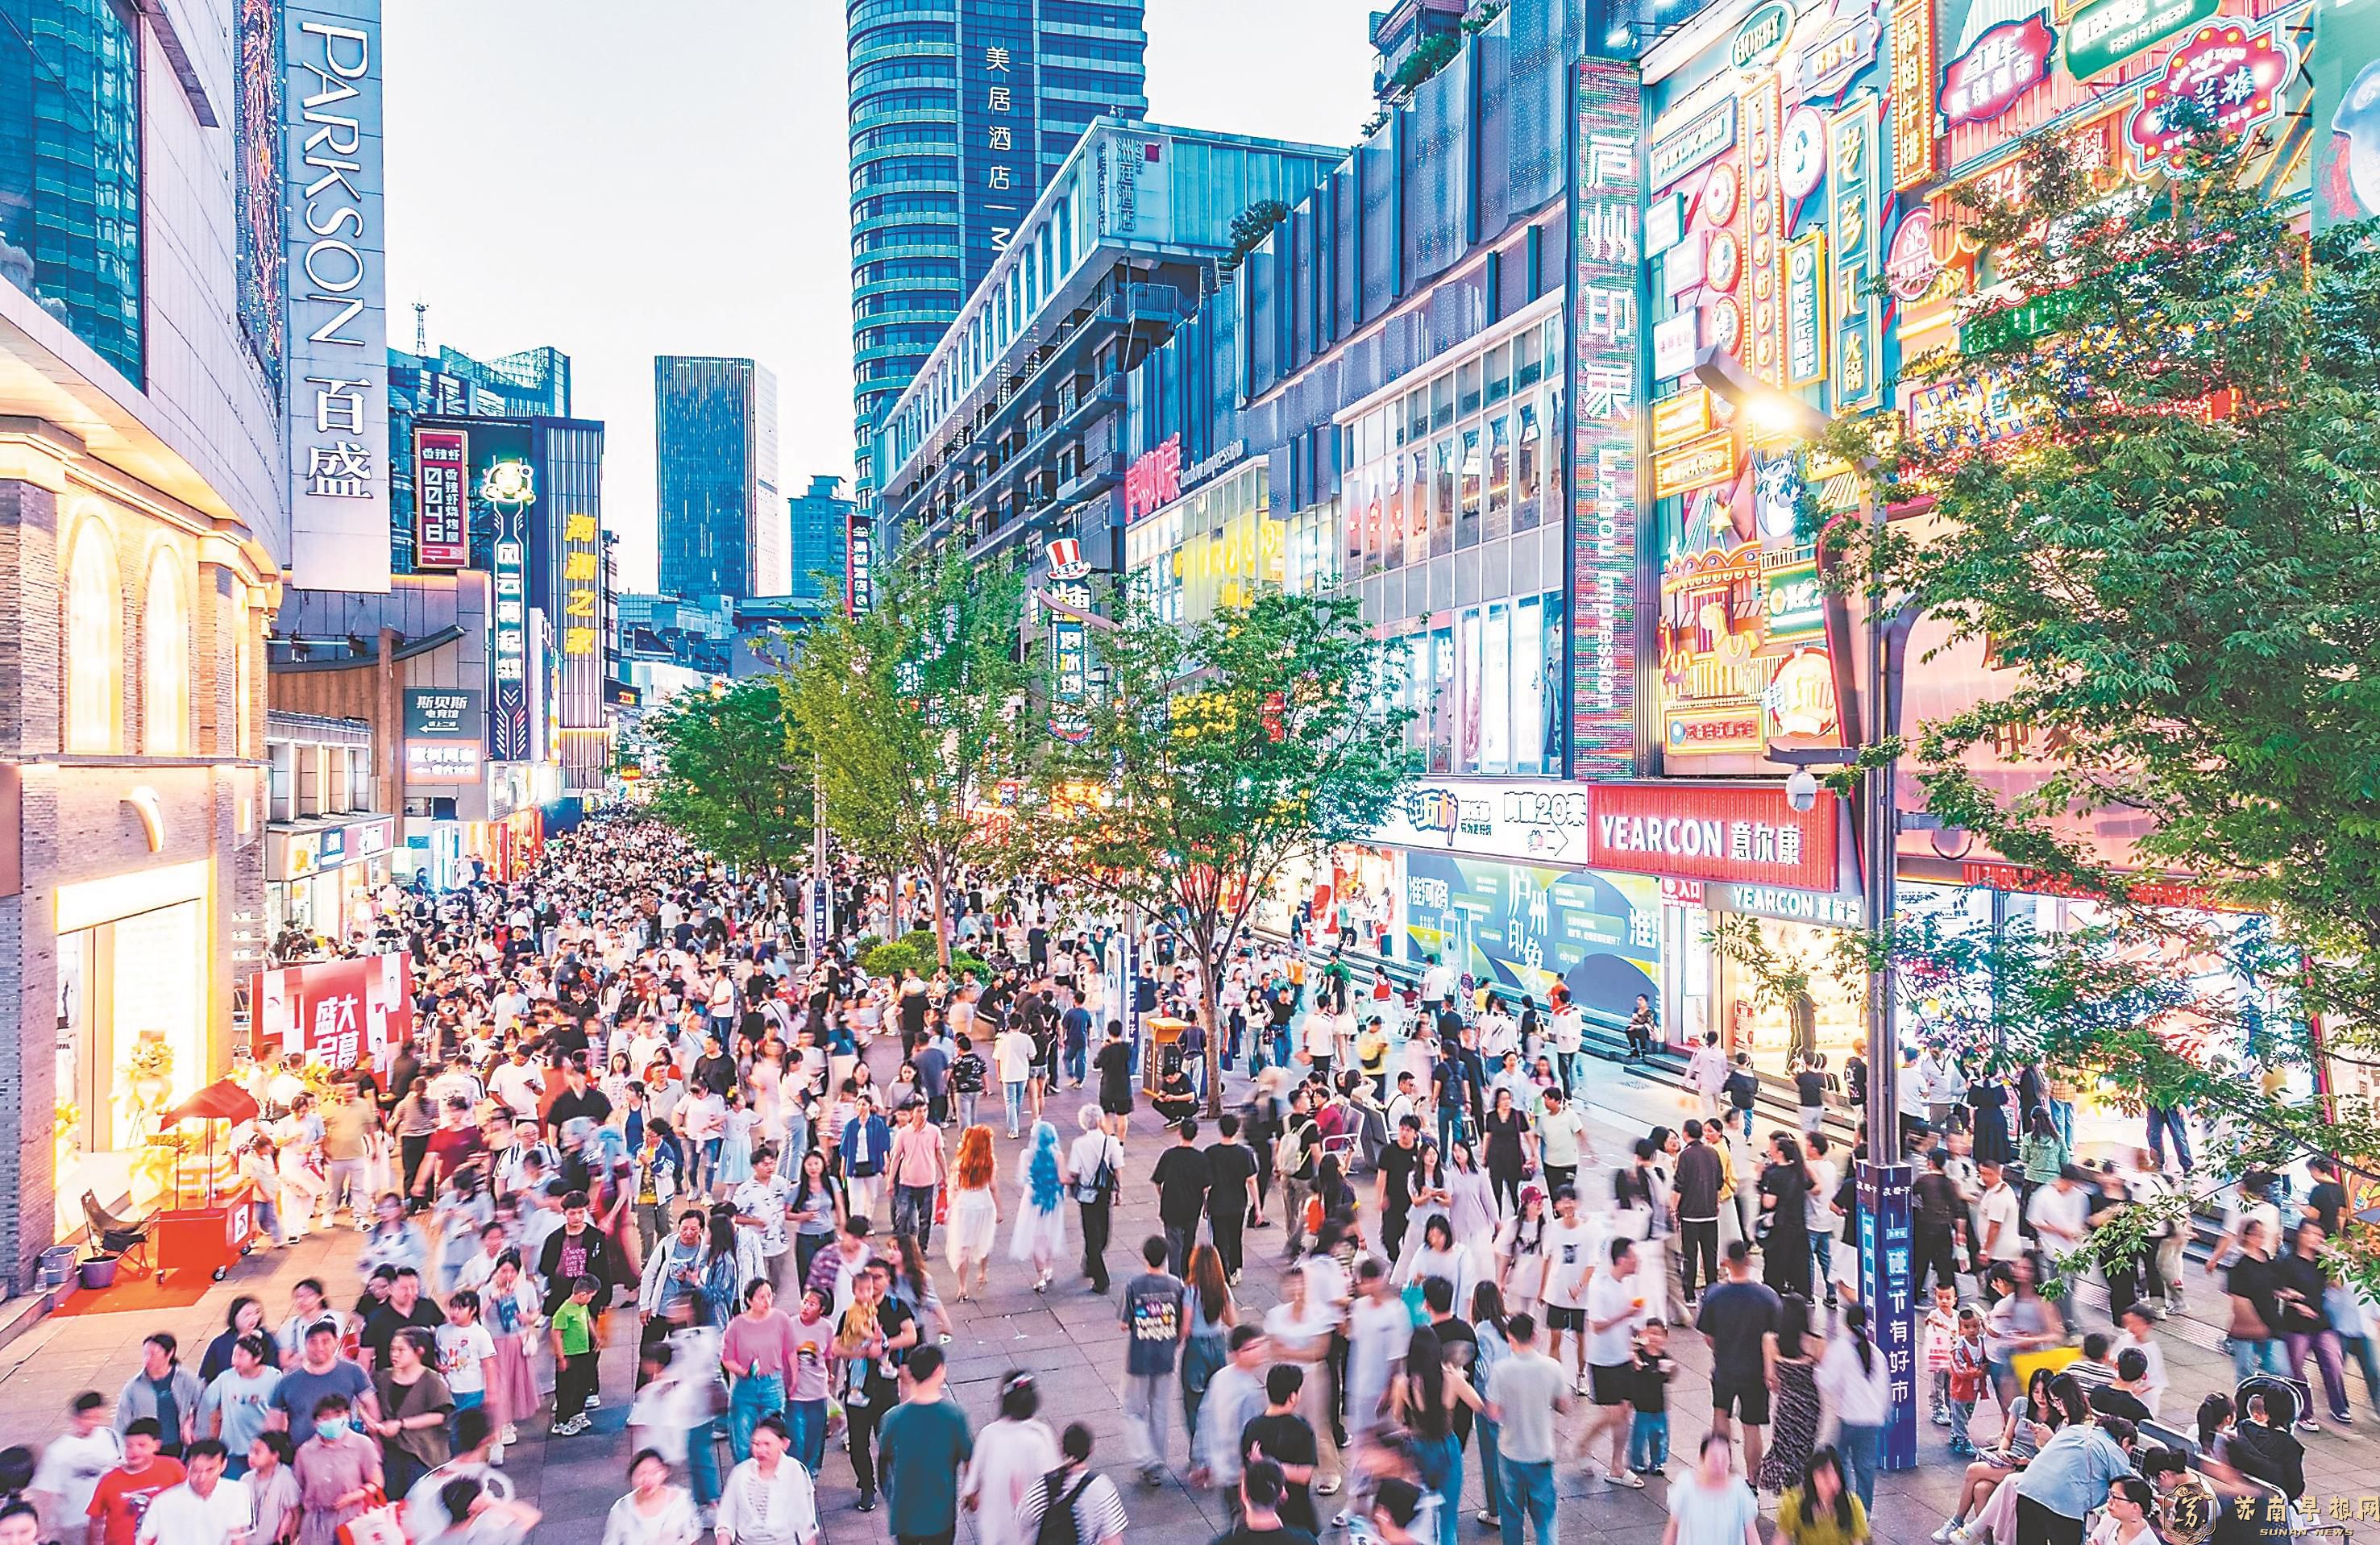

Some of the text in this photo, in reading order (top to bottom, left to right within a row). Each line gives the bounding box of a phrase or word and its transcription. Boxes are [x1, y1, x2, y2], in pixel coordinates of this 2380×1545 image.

[1734, 10, 1783, 67] HOBBY
[986, 45, 1011, 191] 美居酒店
[301, 21, 369, 347] PARKSON
[305, 375, 374, 500] 百盛
[424, 467, 444, 542] 0048
[416, 696, 468, 709] 斯贝斯
[1599, 815, 1804, 866] YEARCON 意尔康
[1679, 879, 1701, 899] 入口
[1733, 885, 1815, 918] YEARCON
[313, 992, 359, 1037] 盛大
